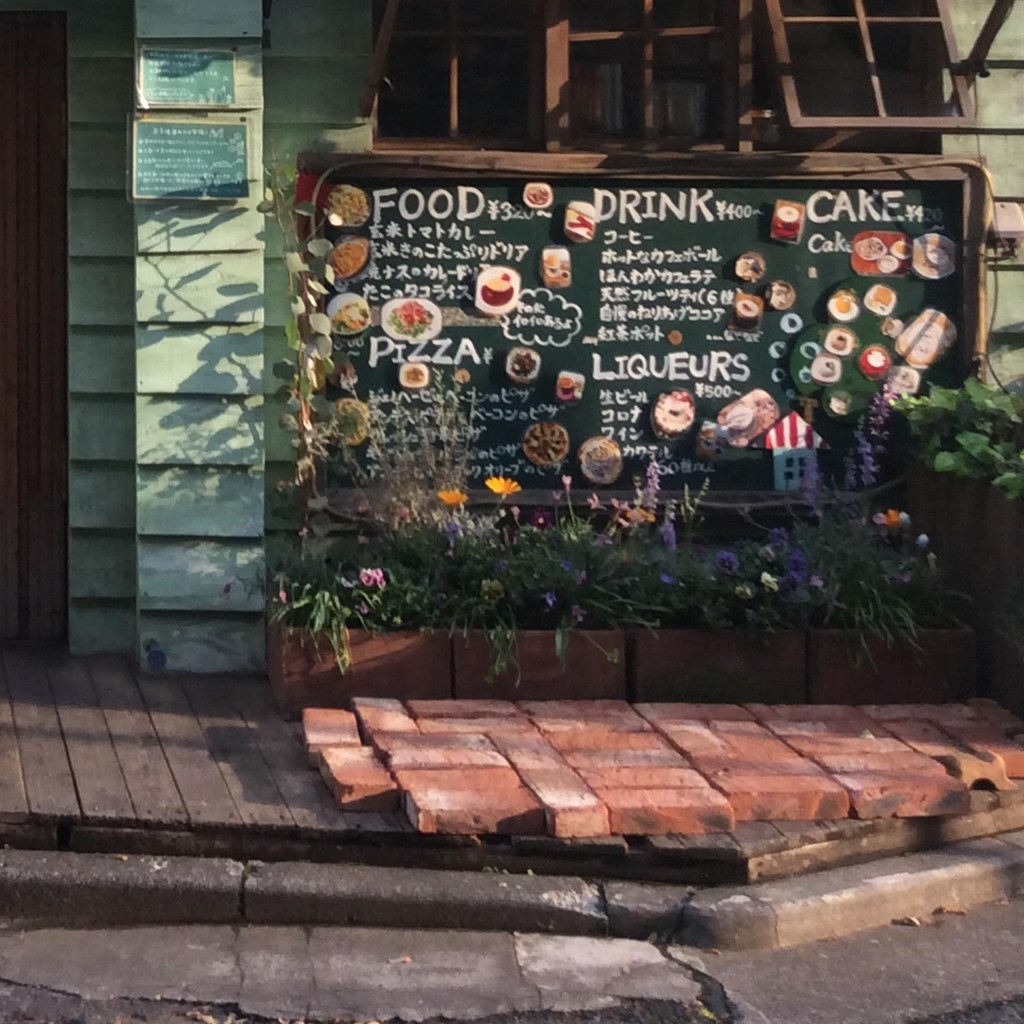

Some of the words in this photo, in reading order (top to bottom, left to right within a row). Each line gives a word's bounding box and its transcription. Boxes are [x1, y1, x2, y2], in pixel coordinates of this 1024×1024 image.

[372, 185, 485, 224] FOOD
[593, 188, 715, 224] DRINK
[806, 189, 905, 223] CAKE
[369, 221, 496, 241] 玄米トマトカレー
[603, 230, 654, 245] コーヒー
[362, 283, 474, 301] たこのタコライス
[368, 336, 481, 368] PIZZA
[592, 351, 751, 382] LIQUEURS
[599, 389, 649, 406] 生ビール
[601, 406, 643, 424] コロナ
[600, 427, 644, 442] ワイン
